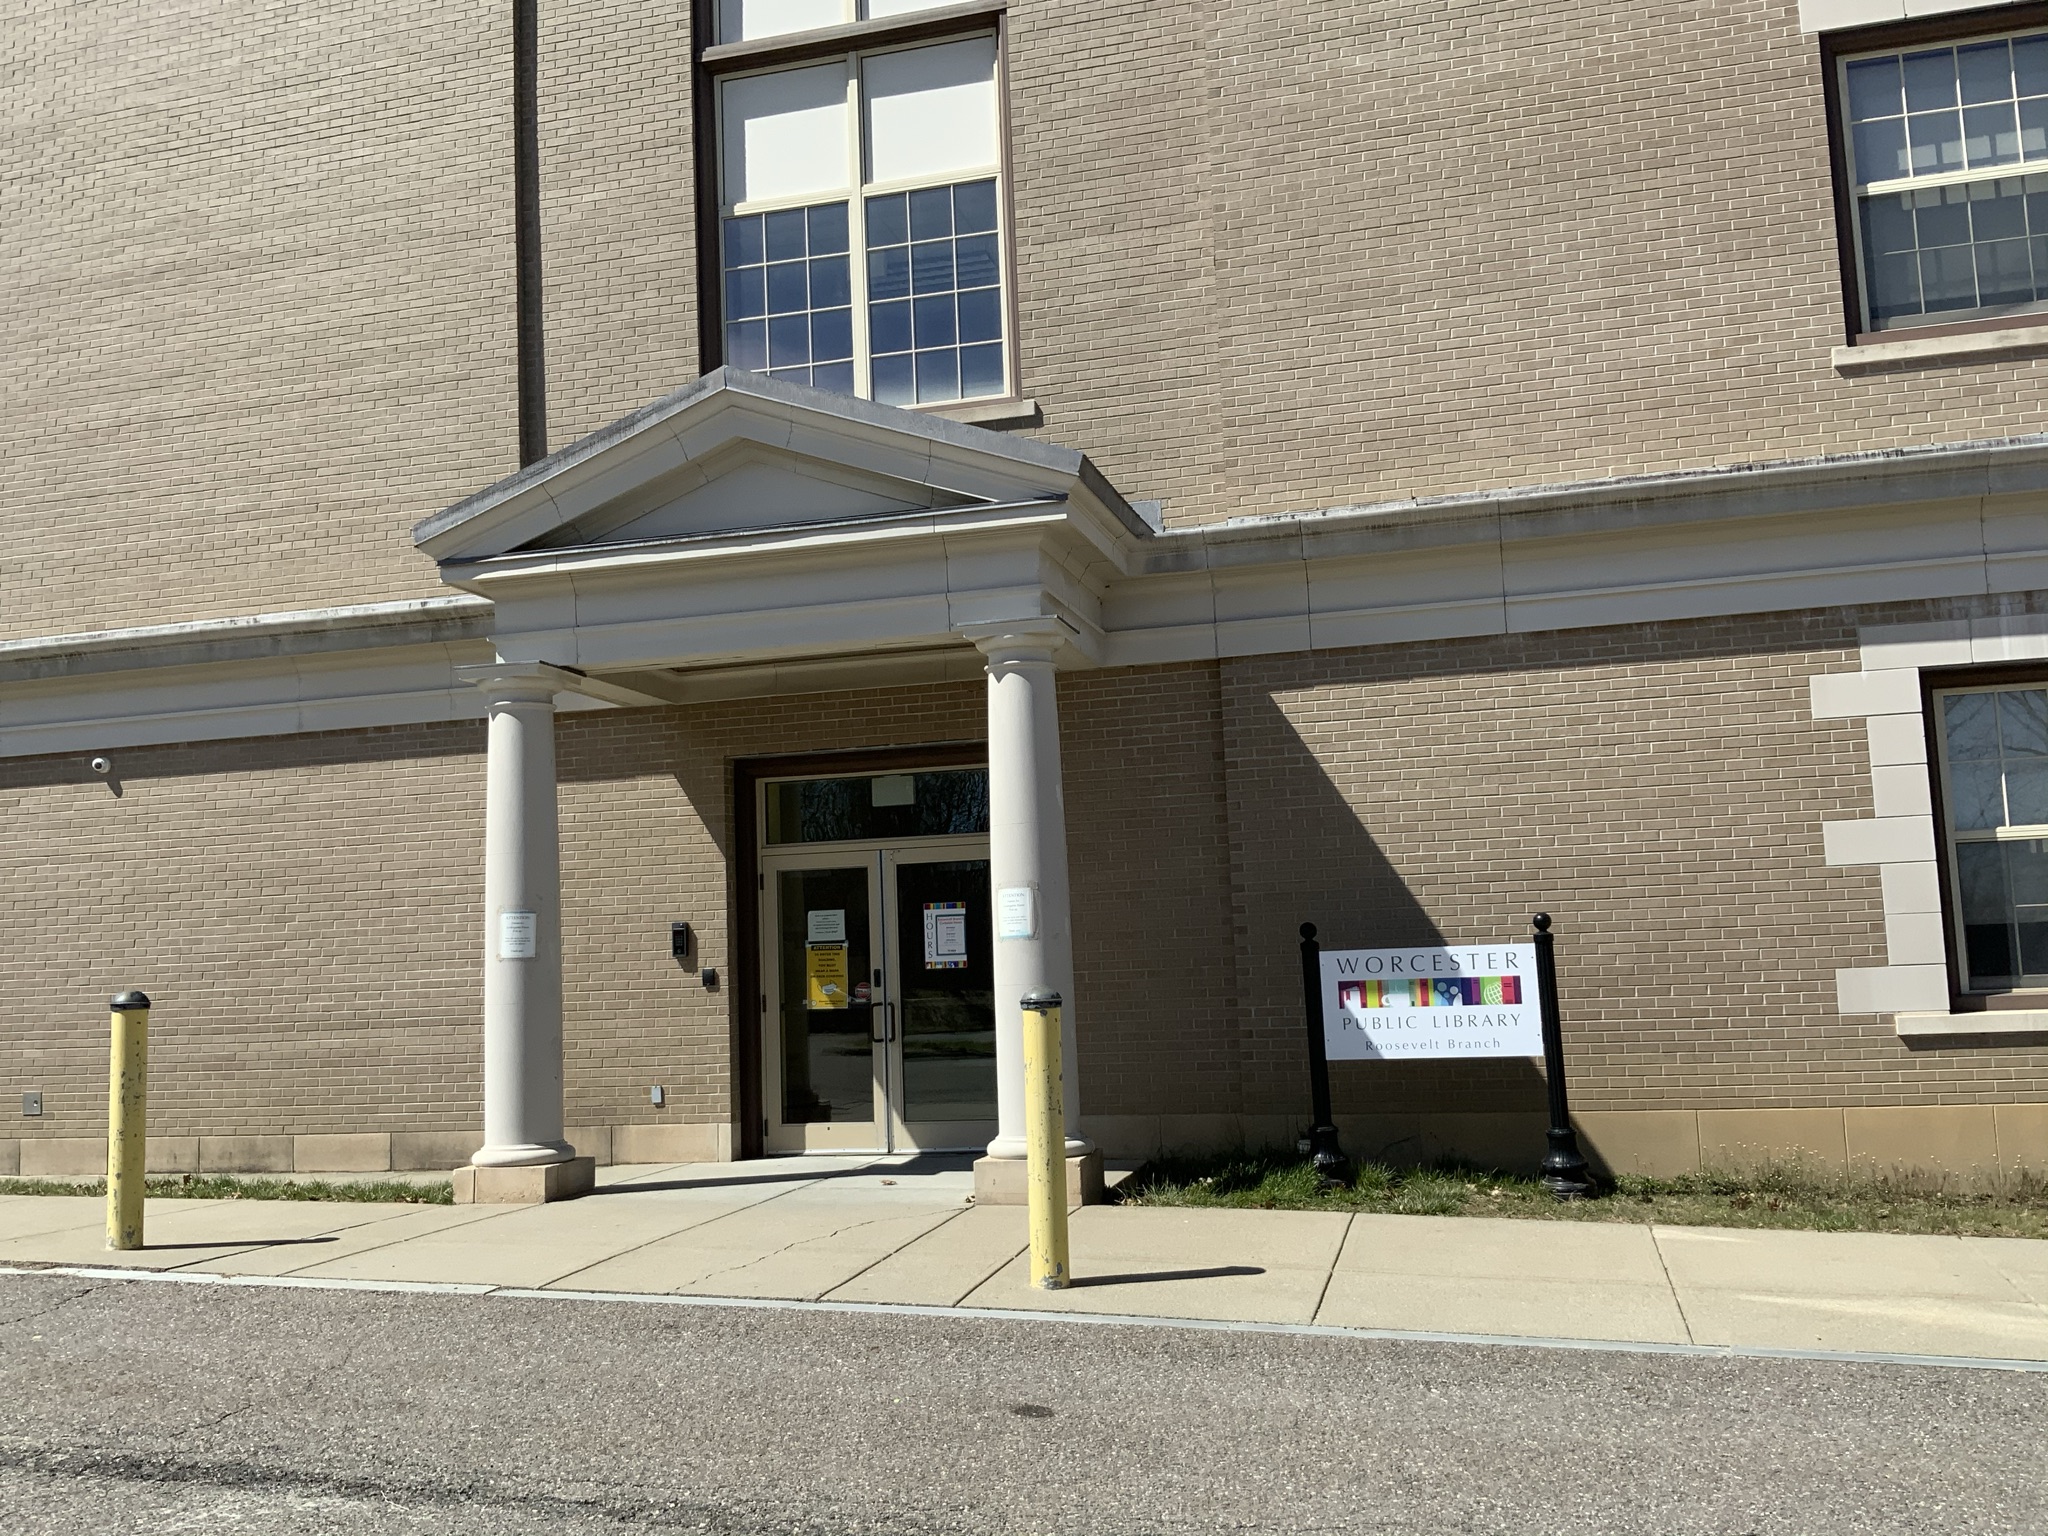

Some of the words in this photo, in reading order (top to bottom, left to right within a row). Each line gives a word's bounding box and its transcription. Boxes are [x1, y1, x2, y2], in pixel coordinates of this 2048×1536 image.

[926, 913, 934, 959] HOURS
[1336, 951, 1519, 974] WORCESTER
[1342, 1016, 1418, 1030] PUBLIC
[1433, 1013, 1521, 1029] LIBRARY
[1365, 1039, 1440, 1051] Roosevelt
[1448, 1037, 1501, 1049] Branch
